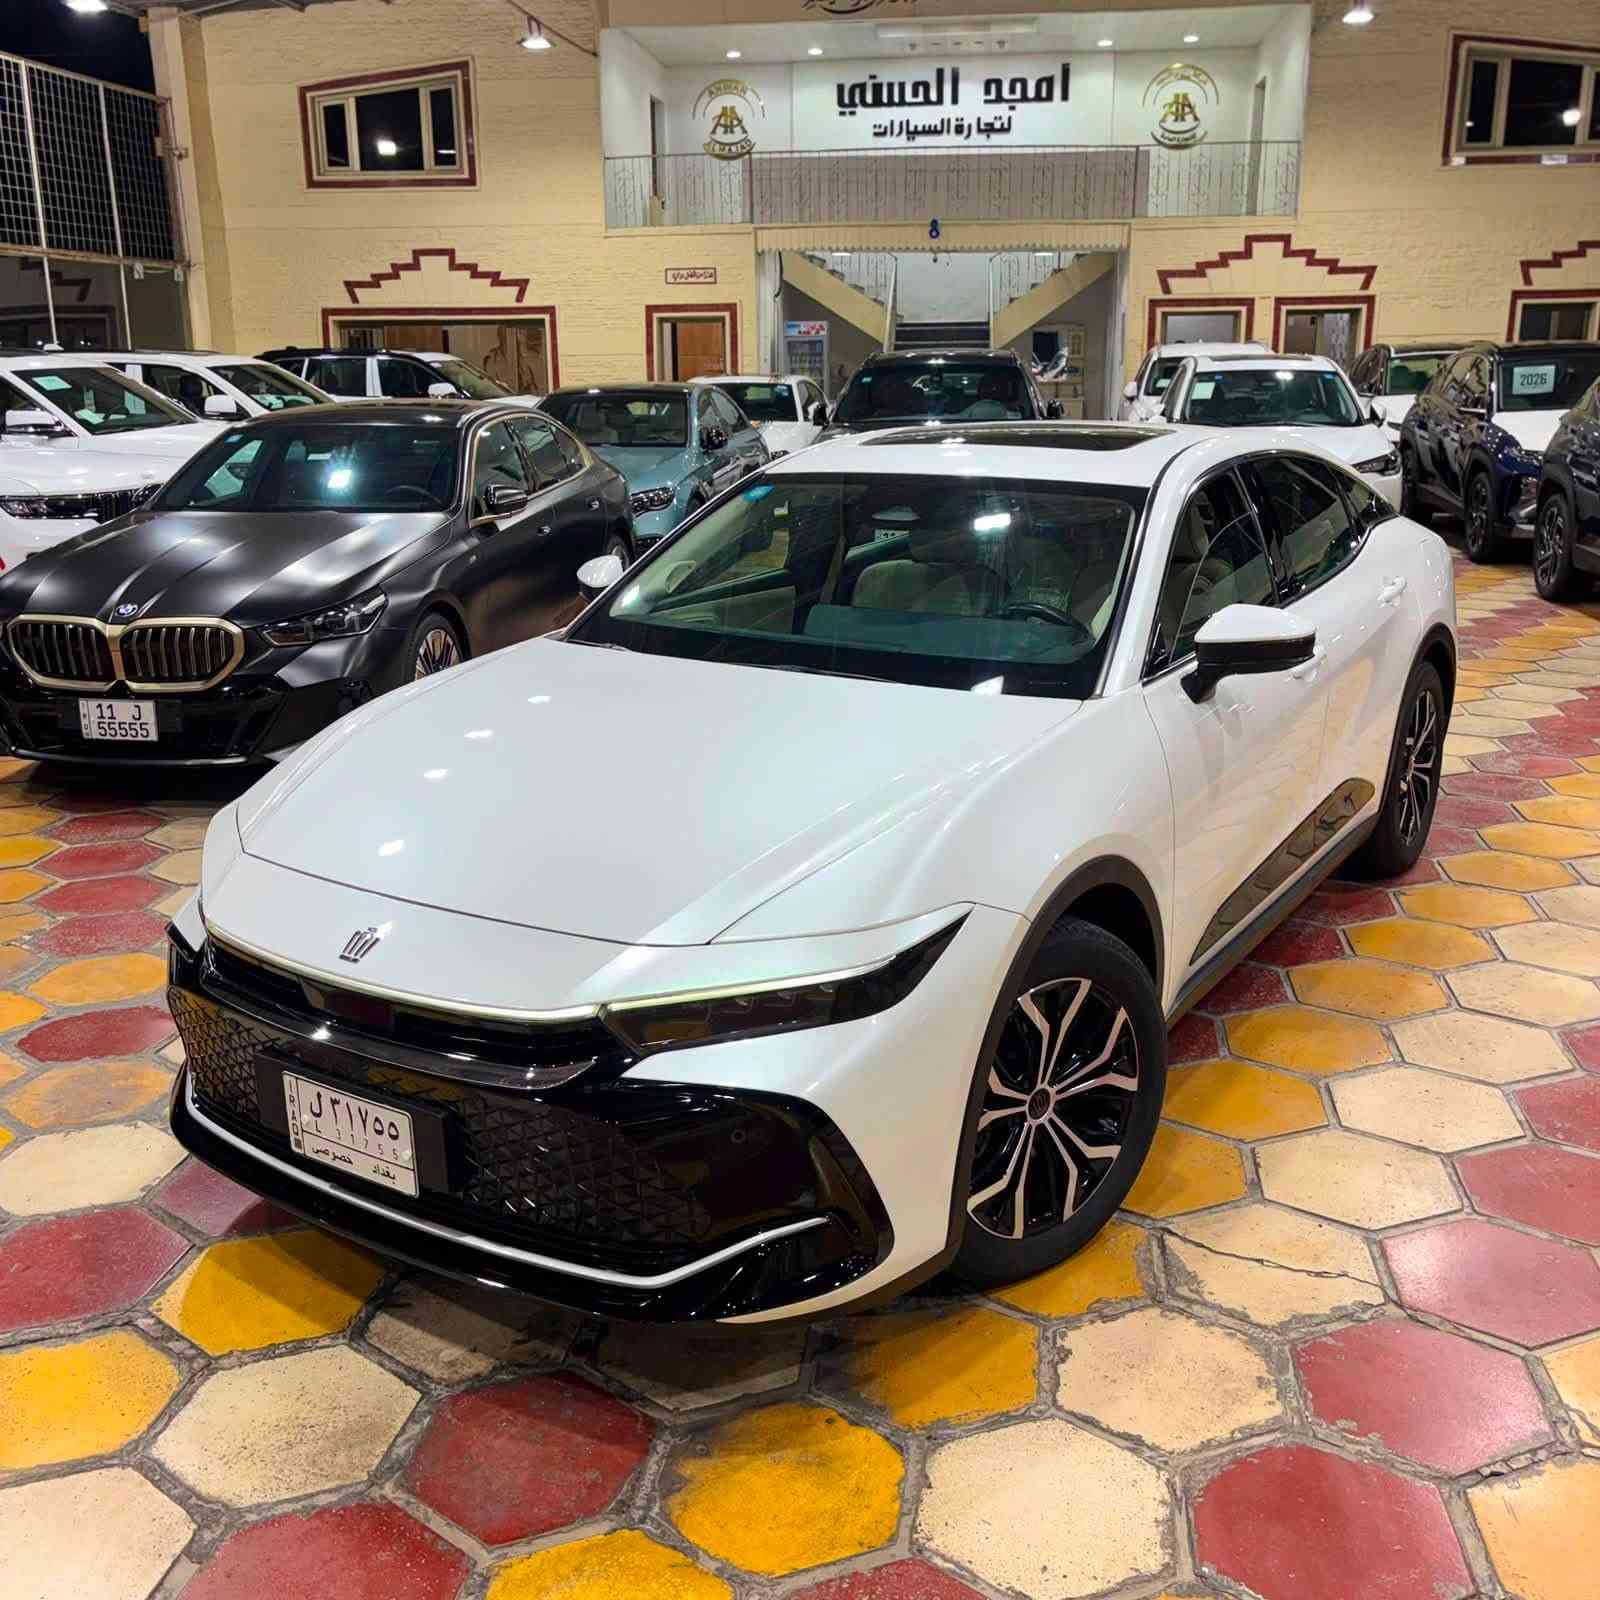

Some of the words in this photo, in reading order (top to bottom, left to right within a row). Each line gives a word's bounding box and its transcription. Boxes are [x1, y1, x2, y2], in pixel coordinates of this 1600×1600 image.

[836, 66, 960, 116] الحسني
[983, 63, 1071, 111] امجد
[872, 118, 951, 142] السيارات
[953, 115, 1012, 140] لتجارة
[1519, 372, 1548, 387] 2026
[96, 703, 117, 720] 11
[131, 704, 142, 721] J
[97, 721, 150, 738] 55555
[372, 1163, 396, 1185] بغداد
